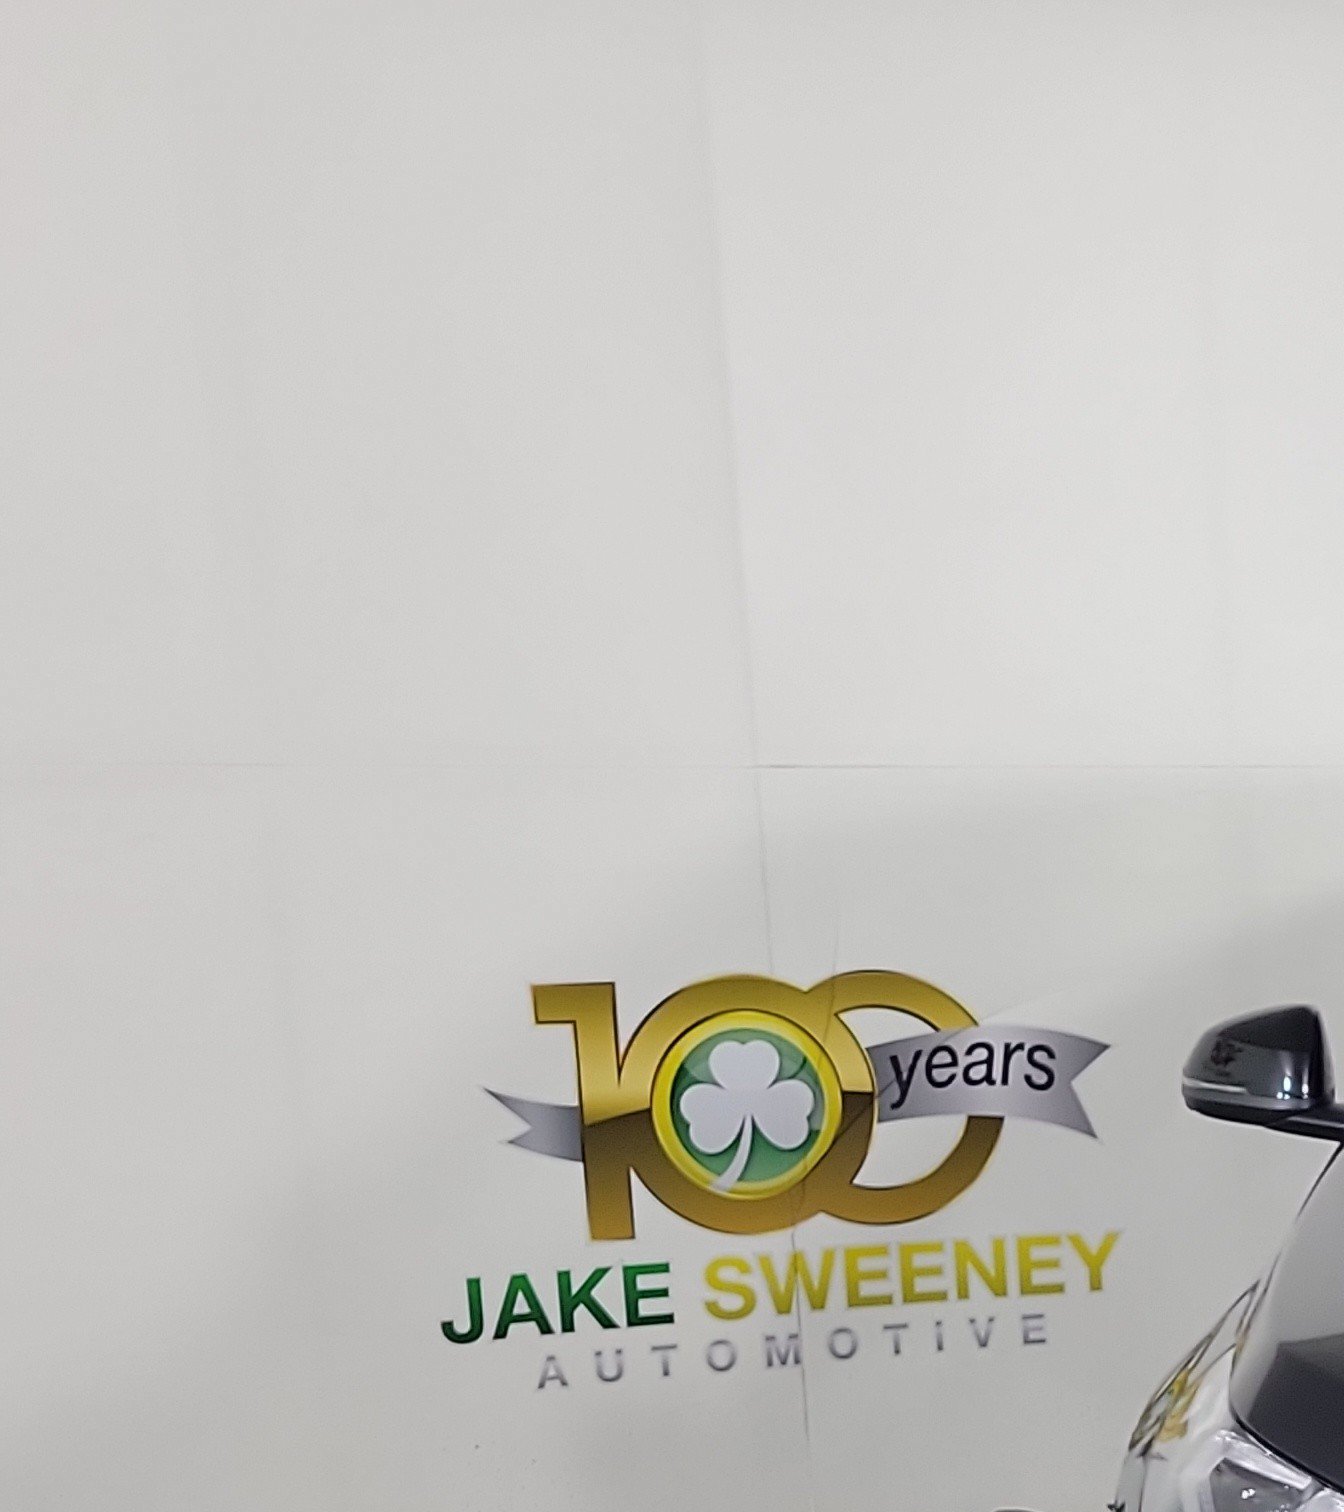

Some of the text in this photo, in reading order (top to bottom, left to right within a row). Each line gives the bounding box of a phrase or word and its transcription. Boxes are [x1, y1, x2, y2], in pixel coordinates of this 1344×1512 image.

[531, 969, 1005, 1243] 100
[889, 1039, 1057, 1110] years
[440, 1231, 1122, 1345] JAKE SWEENEY
[536, 1313, 1050, 1391] AUTOMOTIVE
